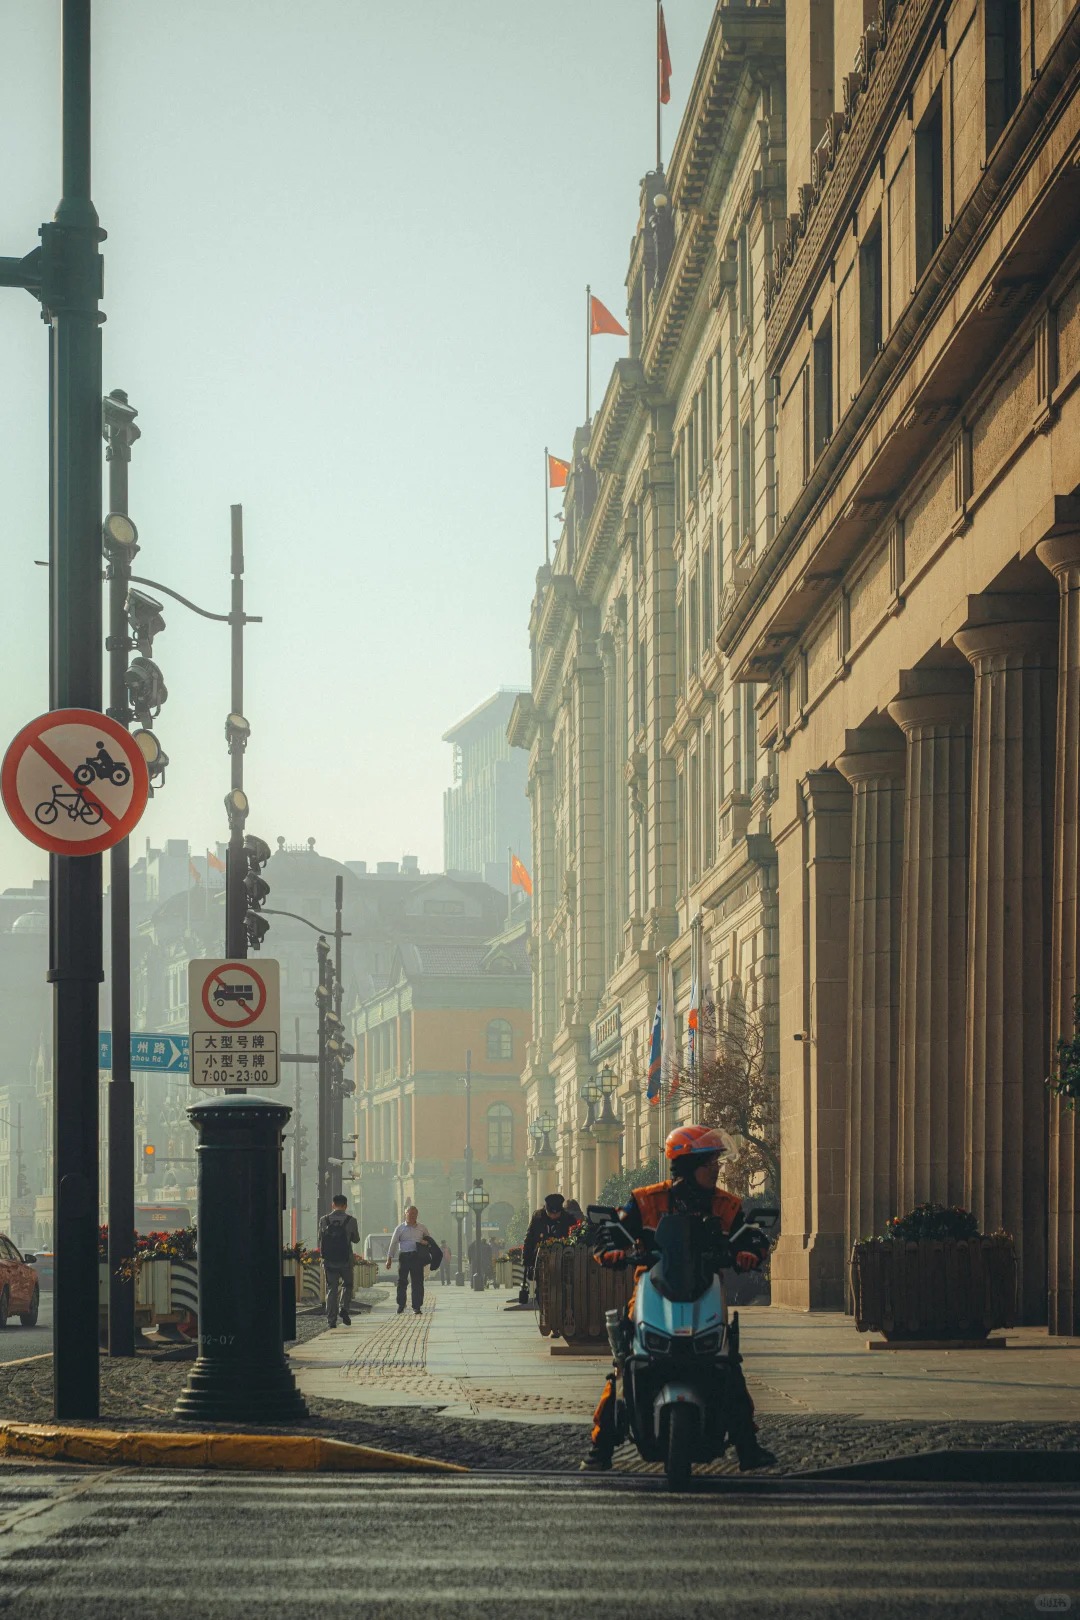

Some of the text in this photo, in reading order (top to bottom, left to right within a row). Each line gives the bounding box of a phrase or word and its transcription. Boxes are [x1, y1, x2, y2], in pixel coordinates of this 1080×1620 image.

[100, 1043, 109, 1051] 东
[130, 1040, 166, 1055] 州路
[204, 1034, 266, 1049] 大型号牌
[205, 1053, 266, 1068] 小型号牌
[201, 1069, 269, 1082] 7:00-23:00
